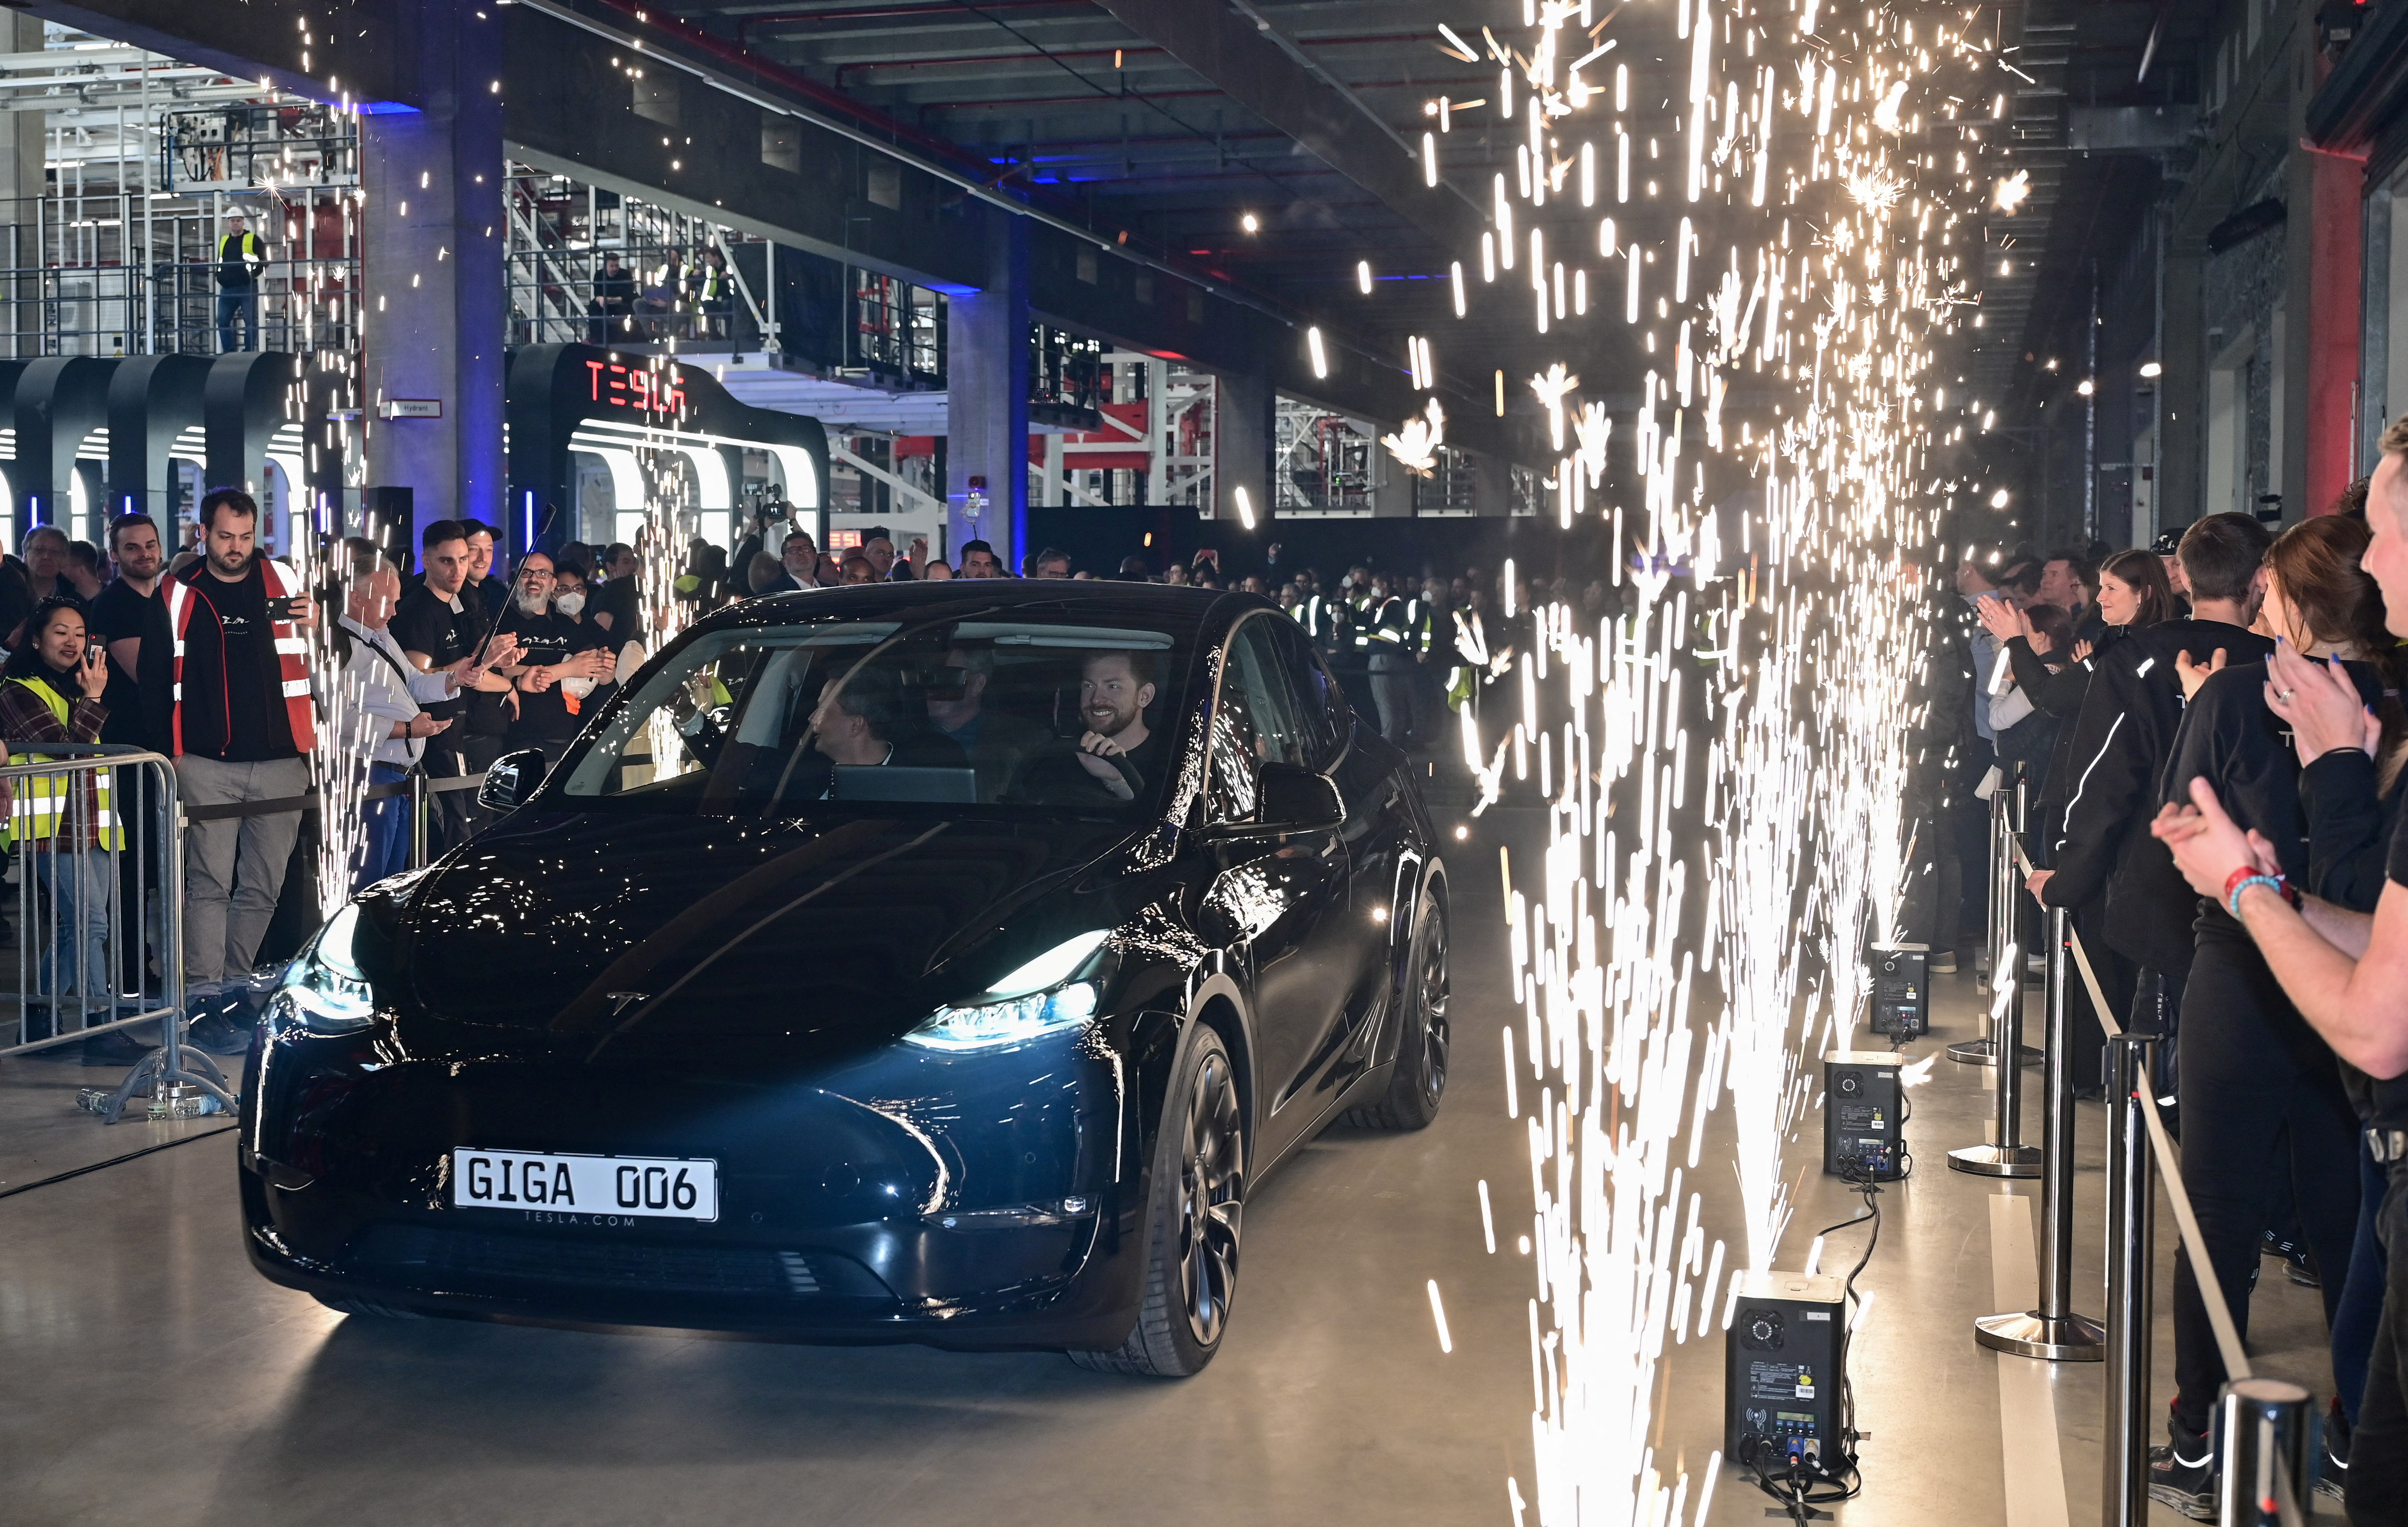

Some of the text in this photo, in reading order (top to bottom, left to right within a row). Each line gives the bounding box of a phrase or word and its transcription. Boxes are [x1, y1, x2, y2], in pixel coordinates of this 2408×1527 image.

[586, 360, 684, 413] TESLA
[469, 1158, 697, 1210] GIGA 006
[525, 1211, 635, 1227] TESLA.COM
